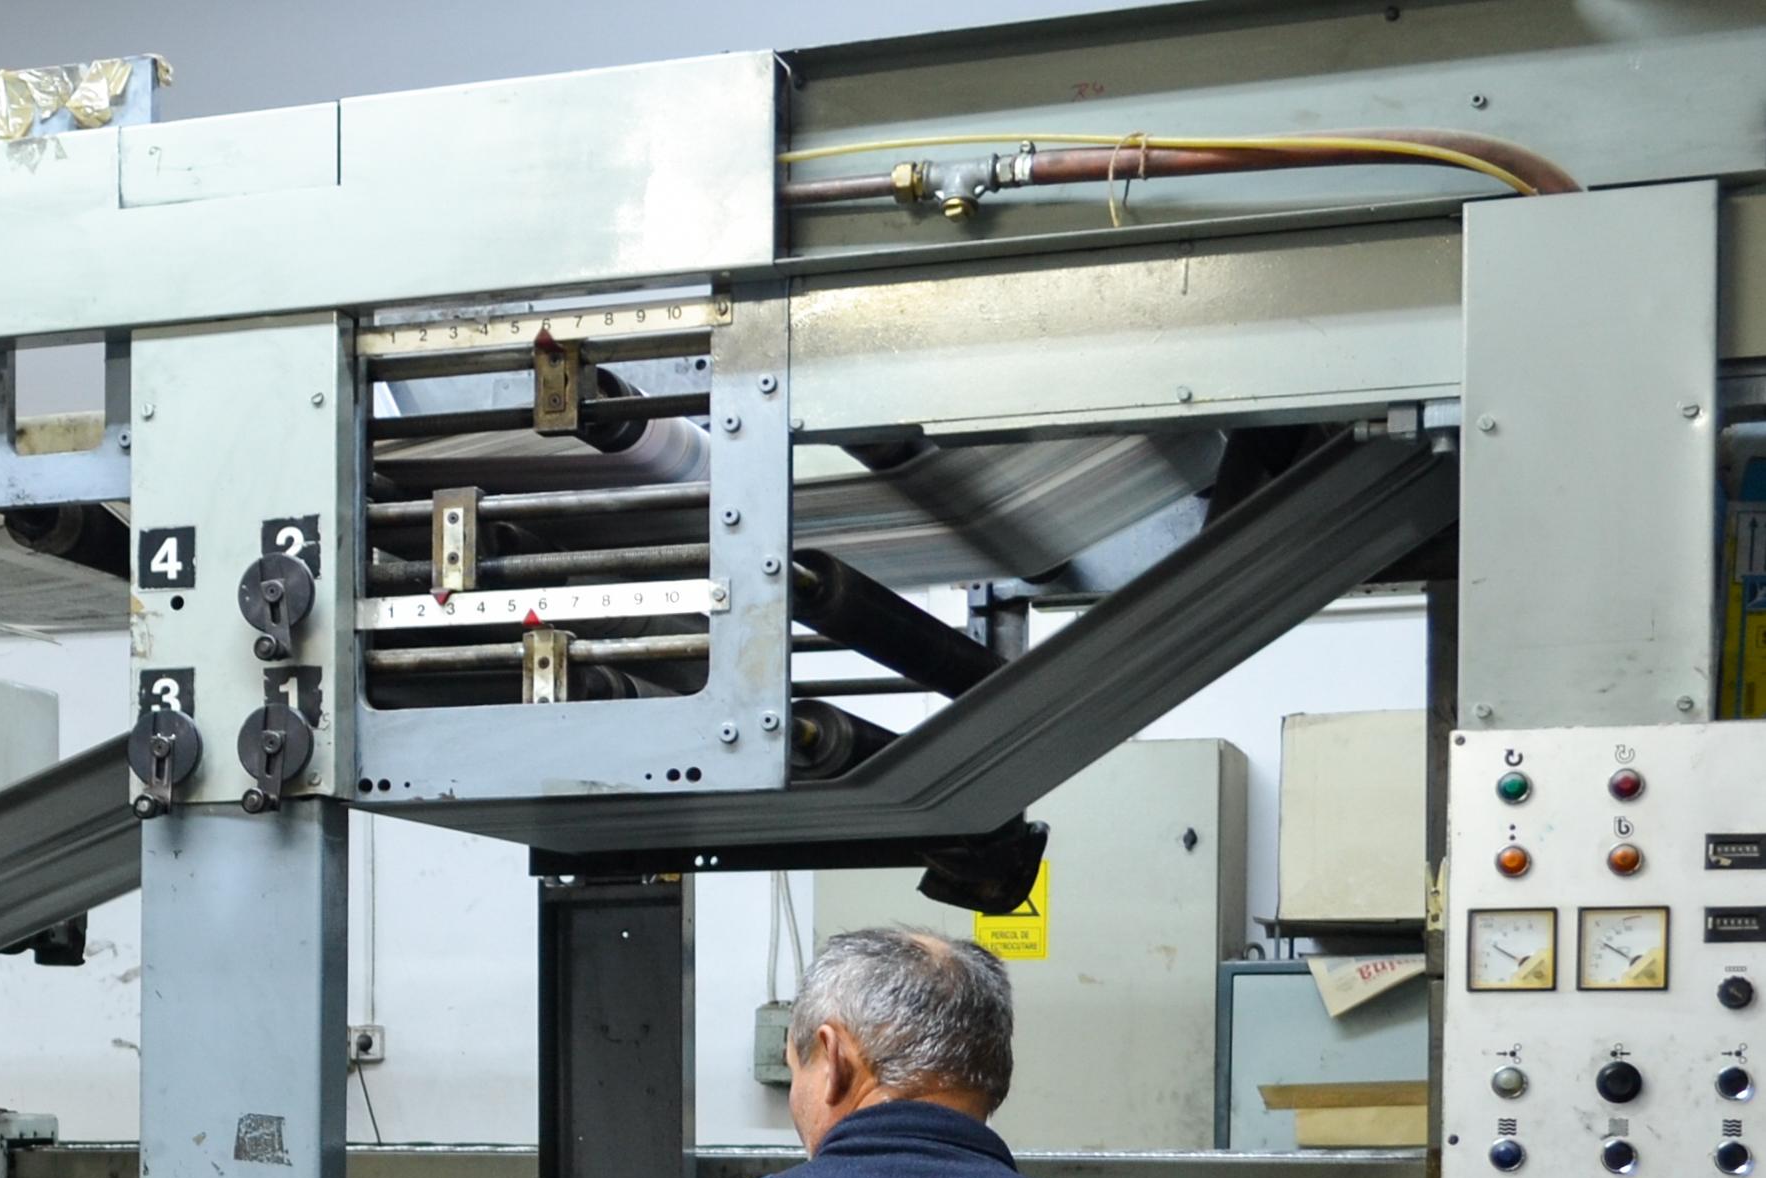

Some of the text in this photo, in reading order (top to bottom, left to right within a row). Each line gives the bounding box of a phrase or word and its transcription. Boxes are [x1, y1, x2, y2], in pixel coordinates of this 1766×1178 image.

[390, 305, 682, 344] 1 2 3 4 5 6 7 8 9 10
[275, 526, 305, 556] 2
[150, 537, 182, 580] 4
[388, 590, 680, 618] 1 2 3 4 5 6 7 8 9 10
[151, 678, 181, 712] 3
[279, 676, 299, 708] 1
